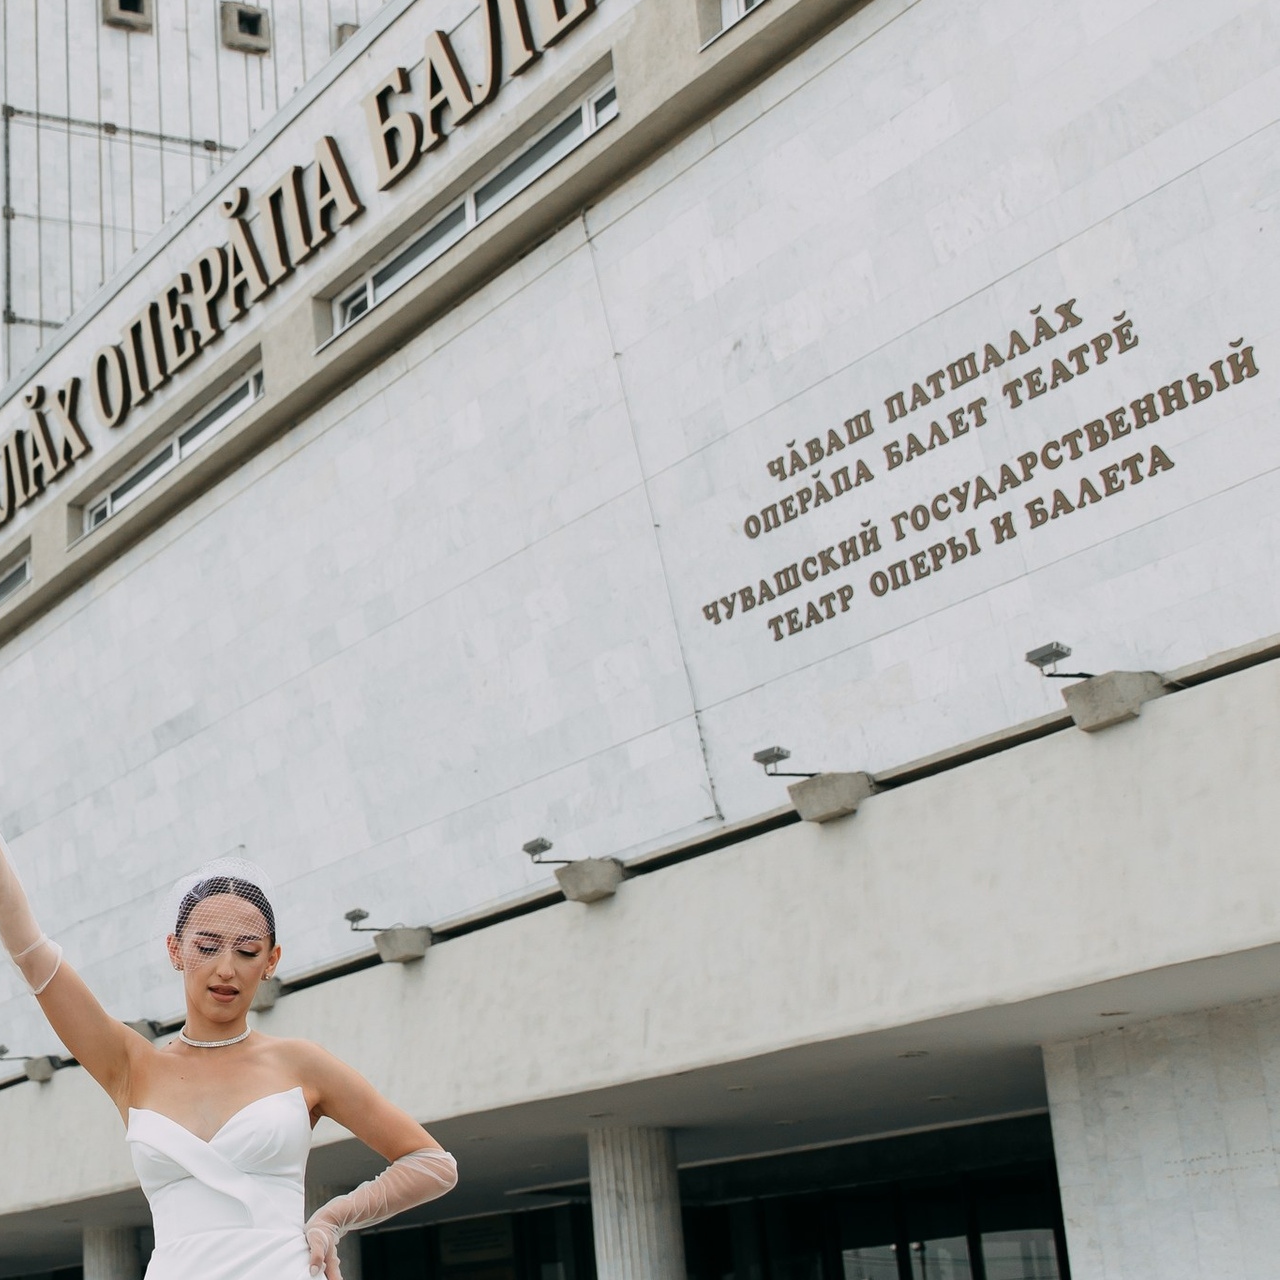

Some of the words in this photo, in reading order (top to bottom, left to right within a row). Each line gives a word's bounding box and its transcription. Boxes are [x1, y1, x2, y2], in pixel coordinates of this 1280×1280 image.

[90, 136, 366, 428] ОПЕРӐПА
[767, 410, 875, 482] ЧӐВАШ
[884, 298, 1083, 423] ПАТШАЛӐХ
[702, 519, 882, 626] ЧУВАШСКИЙ
[890, 337, 1261, 541] ГОСУДАРСТВЕННЫЙ
[743, 470, 875, 539] ОПЕРӐПА
[883, 397, 988, 471] БАЛЕТ
[1002, 310, 1141, 410] ТЕАТРӖ
[768, 584, 855, 642] ТЕАТР
[869, 527, 982, 598] ОПЕРЫ
[991, 511, 1018, 545] И
[1028, 445, 1176, 530] БАЛЕТА
